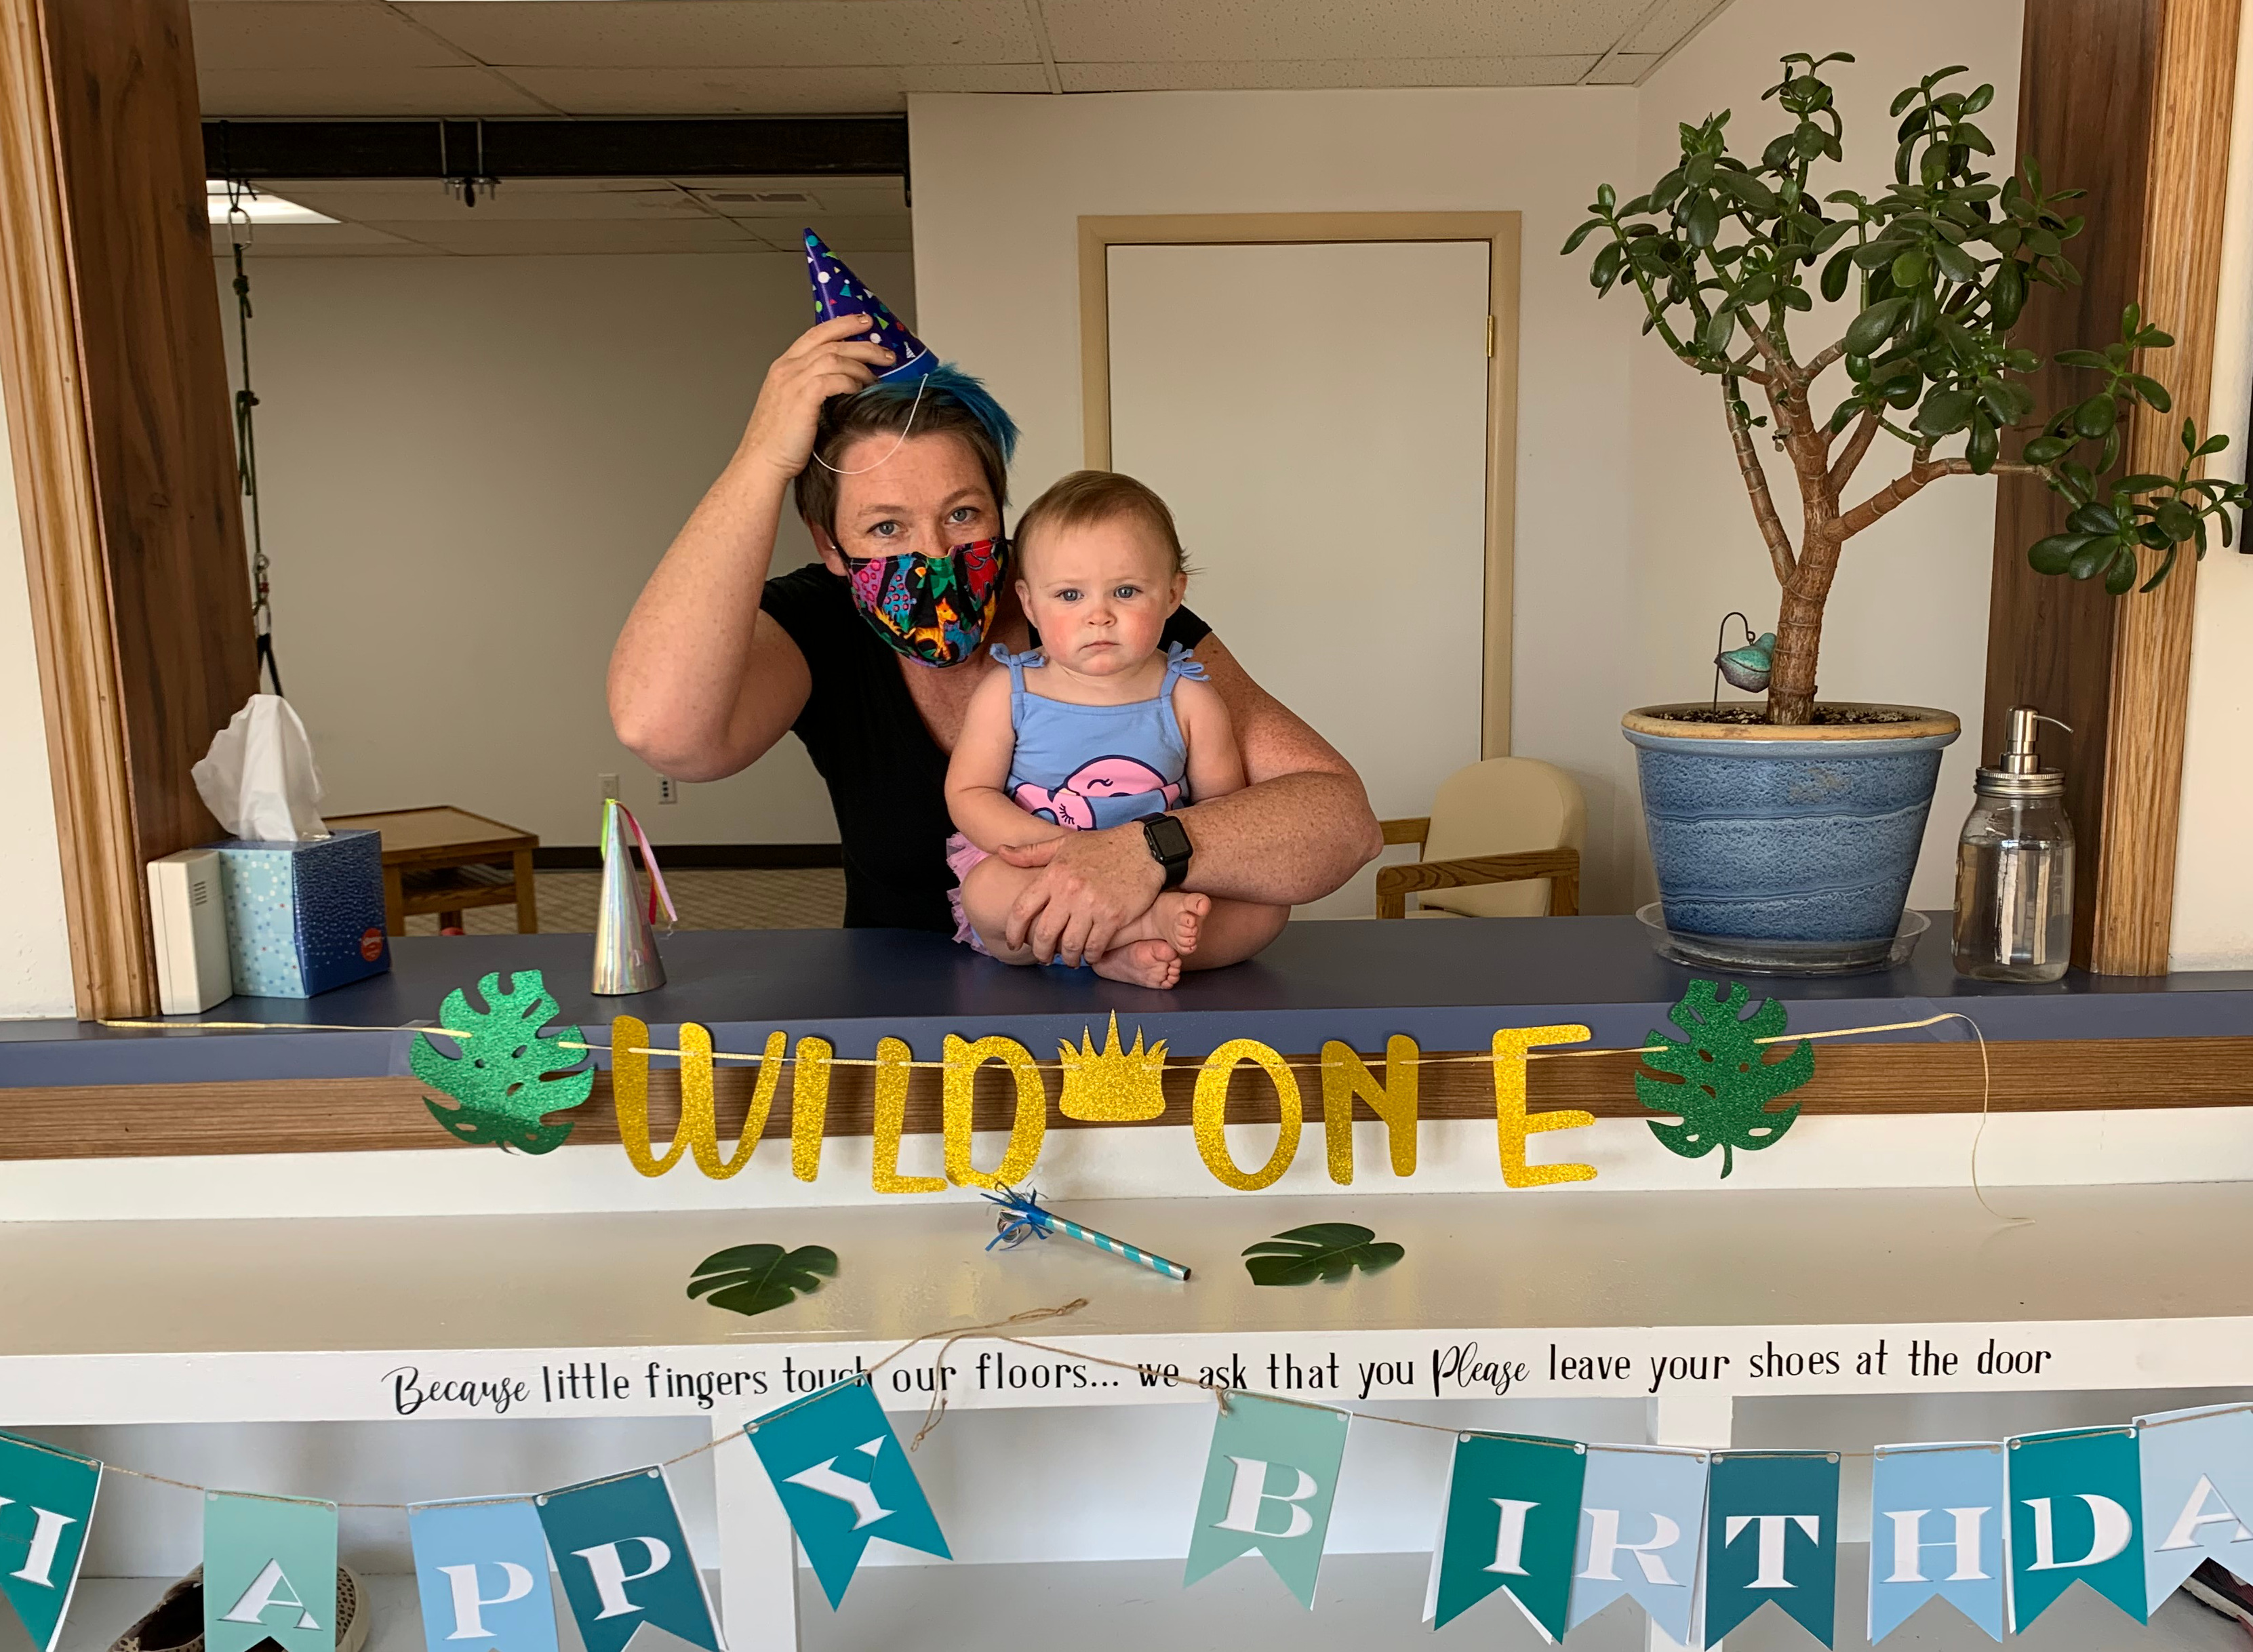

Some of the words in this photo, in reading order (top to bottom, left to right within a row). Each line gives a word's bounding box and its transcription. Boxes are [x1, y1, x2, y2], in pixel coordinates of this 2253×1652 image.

[612, 1014, 1047, 1194] WILD
[1192, 1023, 1599, 1192] ONE
[382, 1365, 531, 1415] Because
[542, 1362, 631, 1403] little
[644, 1361, 768, 1409] fingers
[892, 1365, 957, 1393] our
[975, 1352, 1120, 1390] floors...
[1137, 1358, 1180, 1388] we
[1198, 1352, 1248, 1391] ask
[1266, 1352, 1340, 1390] that
[1357, 1358, 1415, 1401] you
[1432, 1341, 1530, 1398] Please
[1549, 1343, 1631, 1381] leave
[1648, 1354, 1731, 1394] your
[1749, 1340, 1841, 1378] shoes
[1855, 1339, 1889, 1376] at
[1907, 1339, 1959, 1377] the
[1976, 1337, 2052, 1375] door
